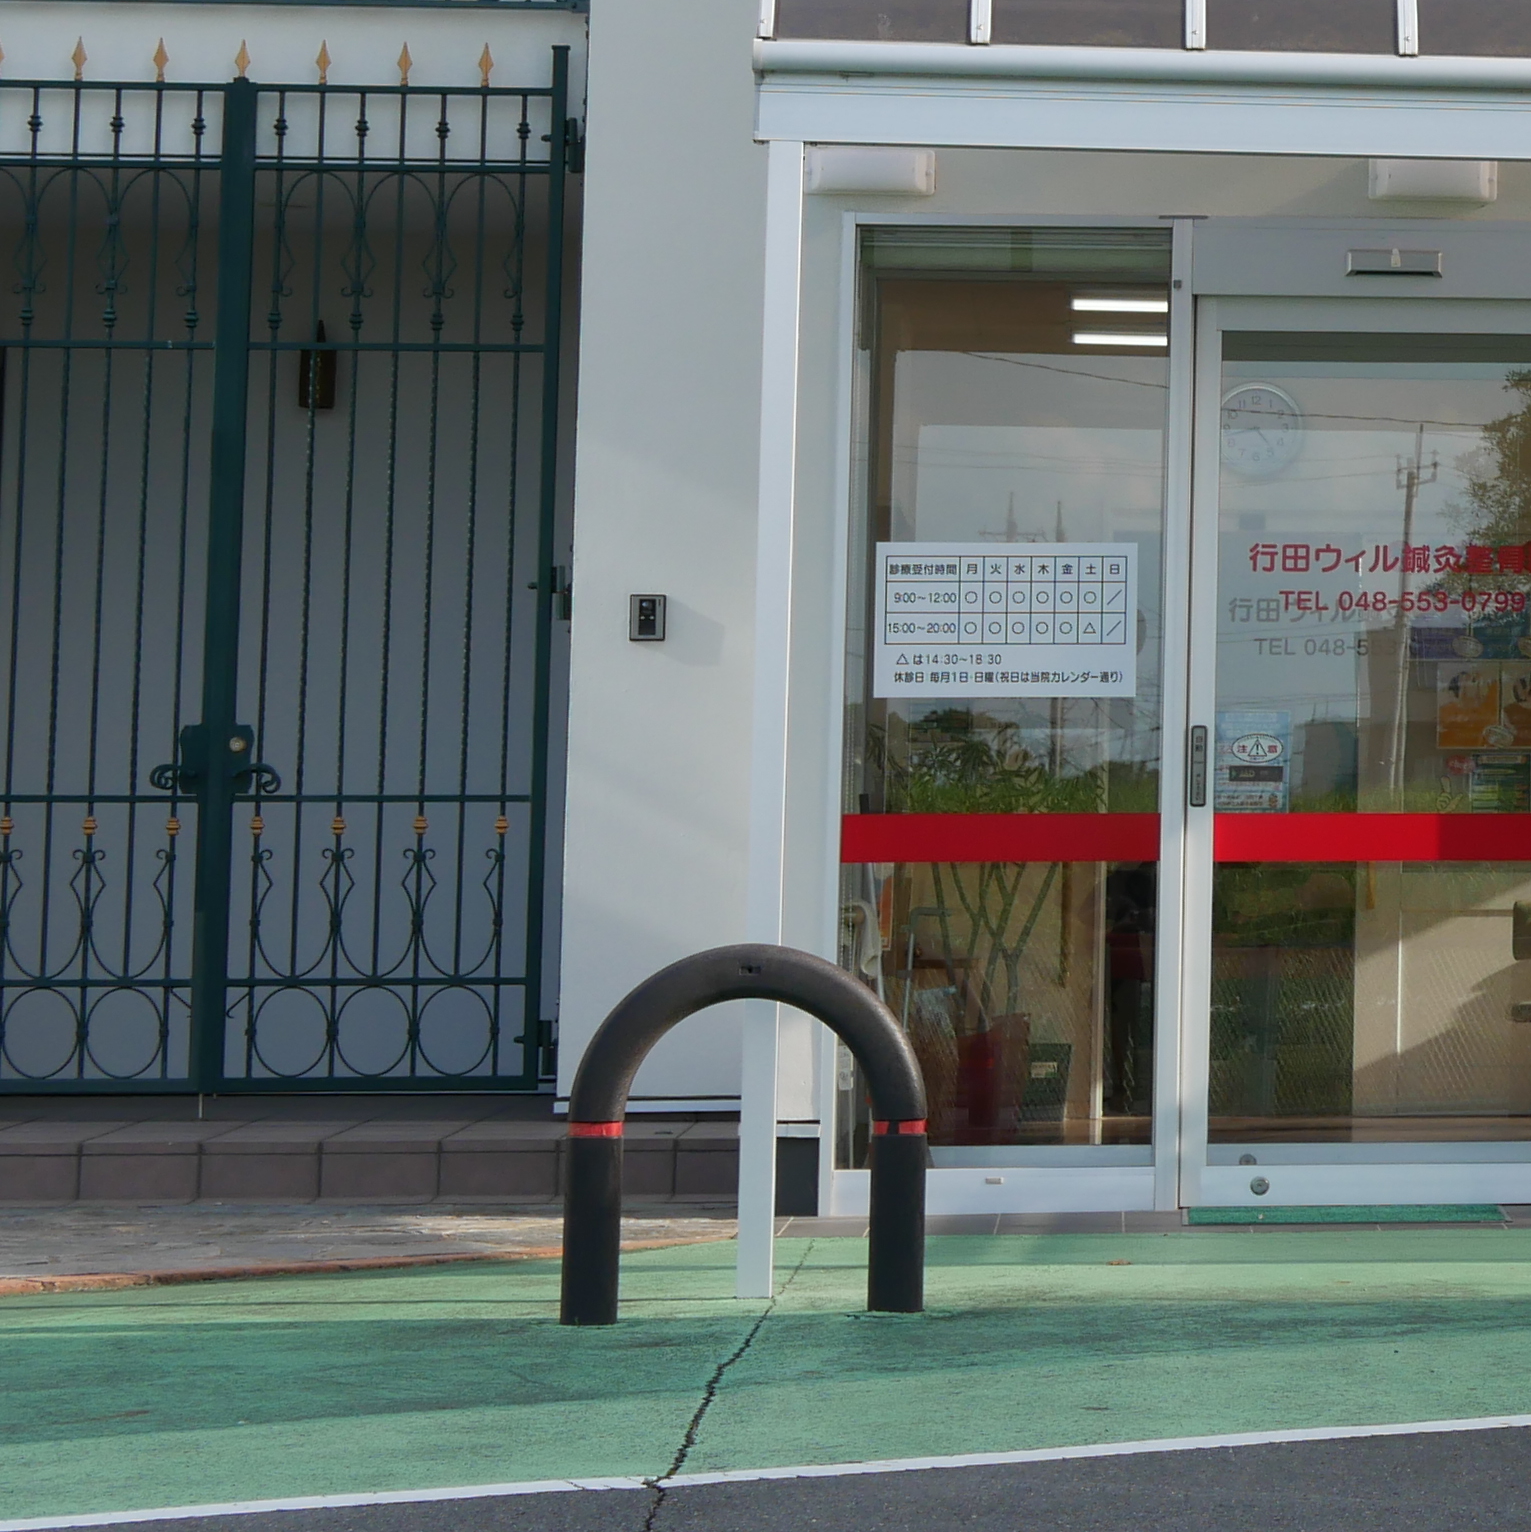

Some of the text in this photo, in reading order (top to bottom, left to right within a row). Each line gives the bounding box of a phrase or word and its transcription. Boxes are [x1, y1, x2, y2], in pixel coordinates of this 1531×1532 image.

[889, 563, 1120, 576] 診療受付時間 月 火 水 木 金 土 日
[1279, 590, 1526, 613] TEL 048-553-0799
